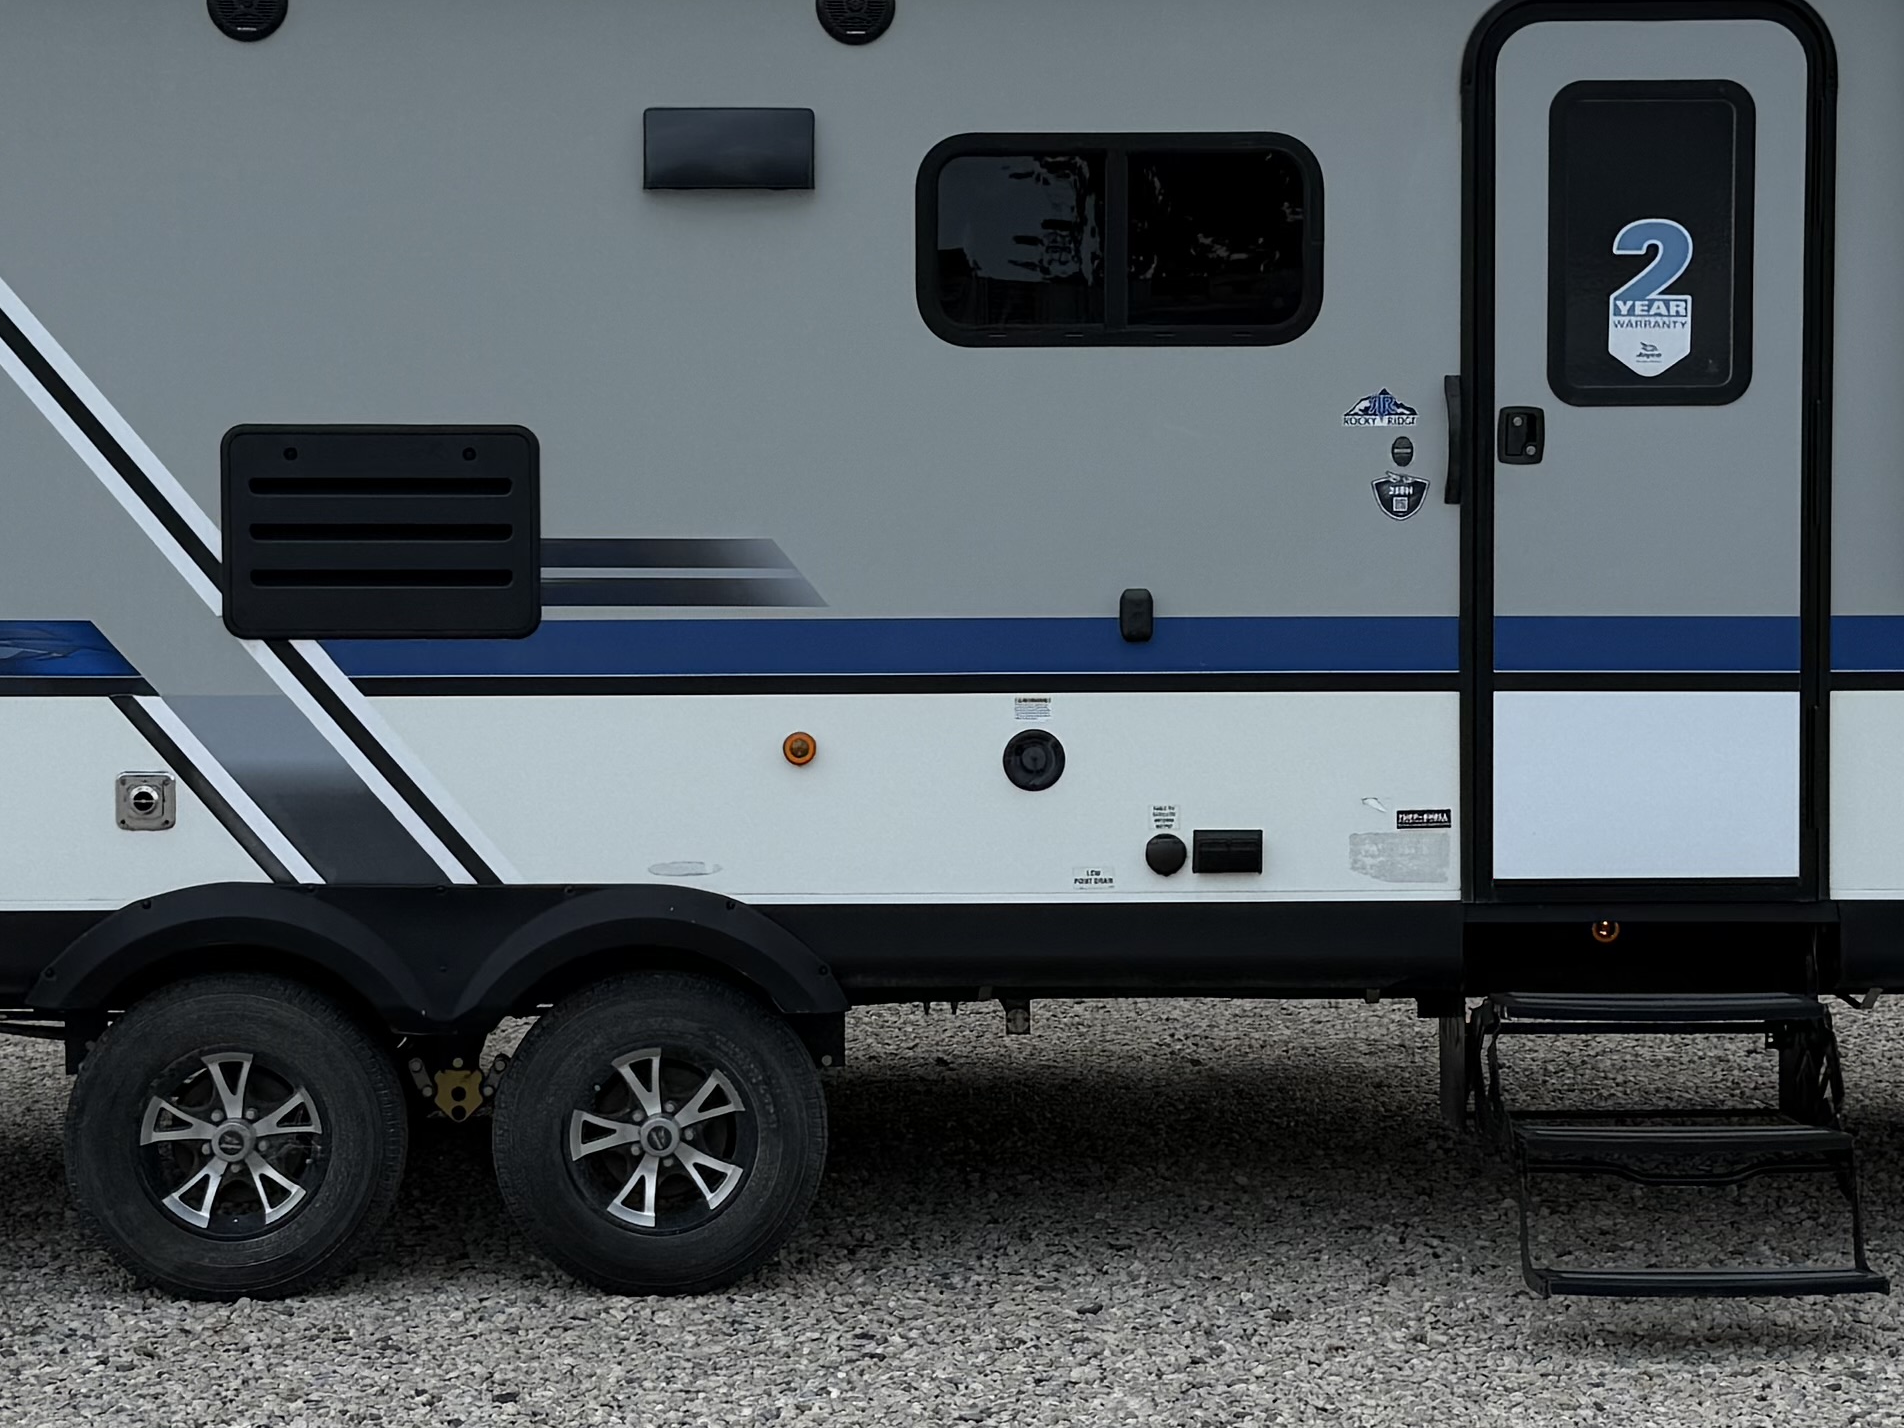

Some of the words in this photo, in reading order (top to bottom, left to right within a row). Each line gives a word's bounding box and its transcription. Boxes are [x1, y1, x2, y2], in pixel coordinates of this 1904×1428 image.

[1613, 218, 1693, 299] 2
[1615, 300, 1687, 316] YEAR
[1612, 319, 1688, 329] WARRANTY
